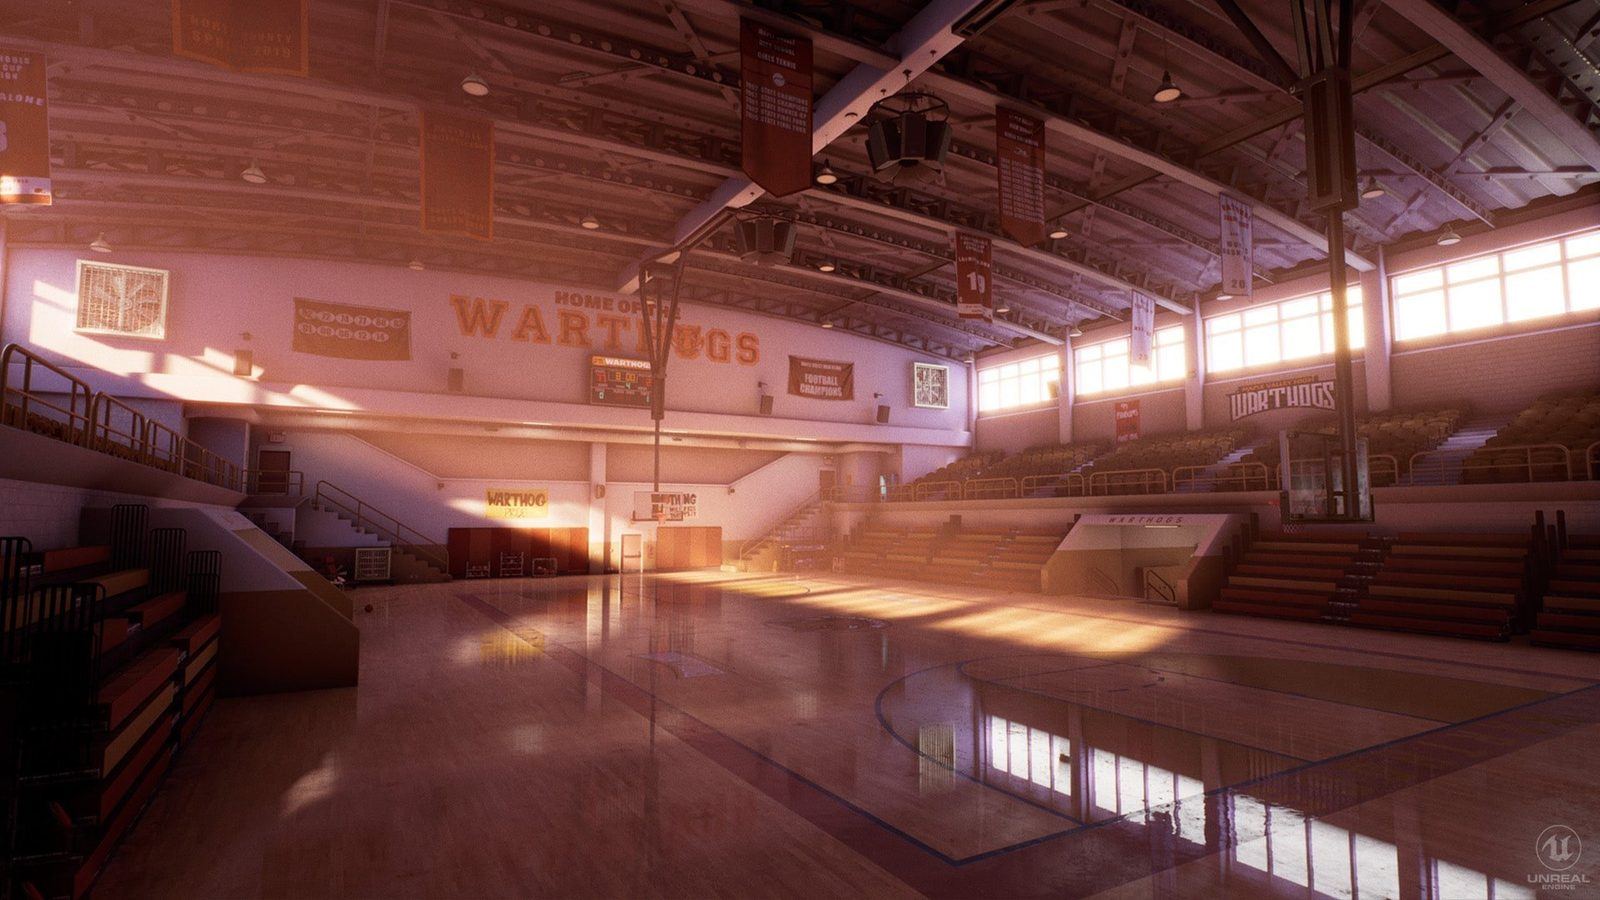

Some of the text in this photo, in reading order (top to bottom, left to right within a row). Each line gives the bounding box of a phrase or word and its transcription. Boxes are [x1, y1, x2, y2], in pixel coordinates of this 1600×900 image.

[554, 290, 613, 310] HOME
[449, 293, 760, 366] WARTGS
[605, 357, 651, 370] WARTHOG
[804, 373, 838, 387] FOOTBALL
[799, 383, 843, 397] CHAMPIONS
[1231, 381, 1336, 421] WARTHOGS
[487, 491, 547, 507] WARTHOG
[1108, 516, 1183, 524] WARTHOGS
